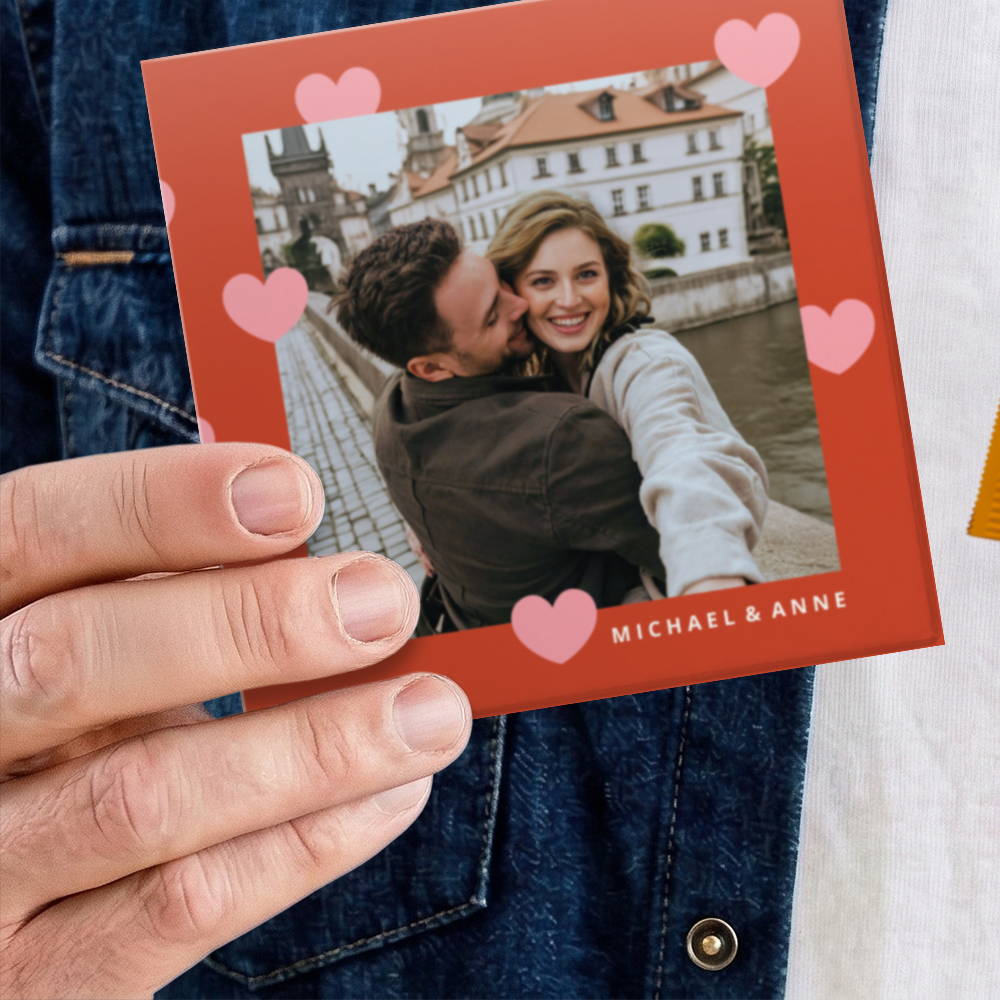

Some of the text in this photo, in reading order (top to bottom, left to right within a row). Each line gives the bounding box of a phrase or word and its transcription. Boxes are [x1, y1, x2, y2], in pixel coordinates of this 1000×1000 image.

[611, 591, 846, 643] MICHAEL & ANNE
